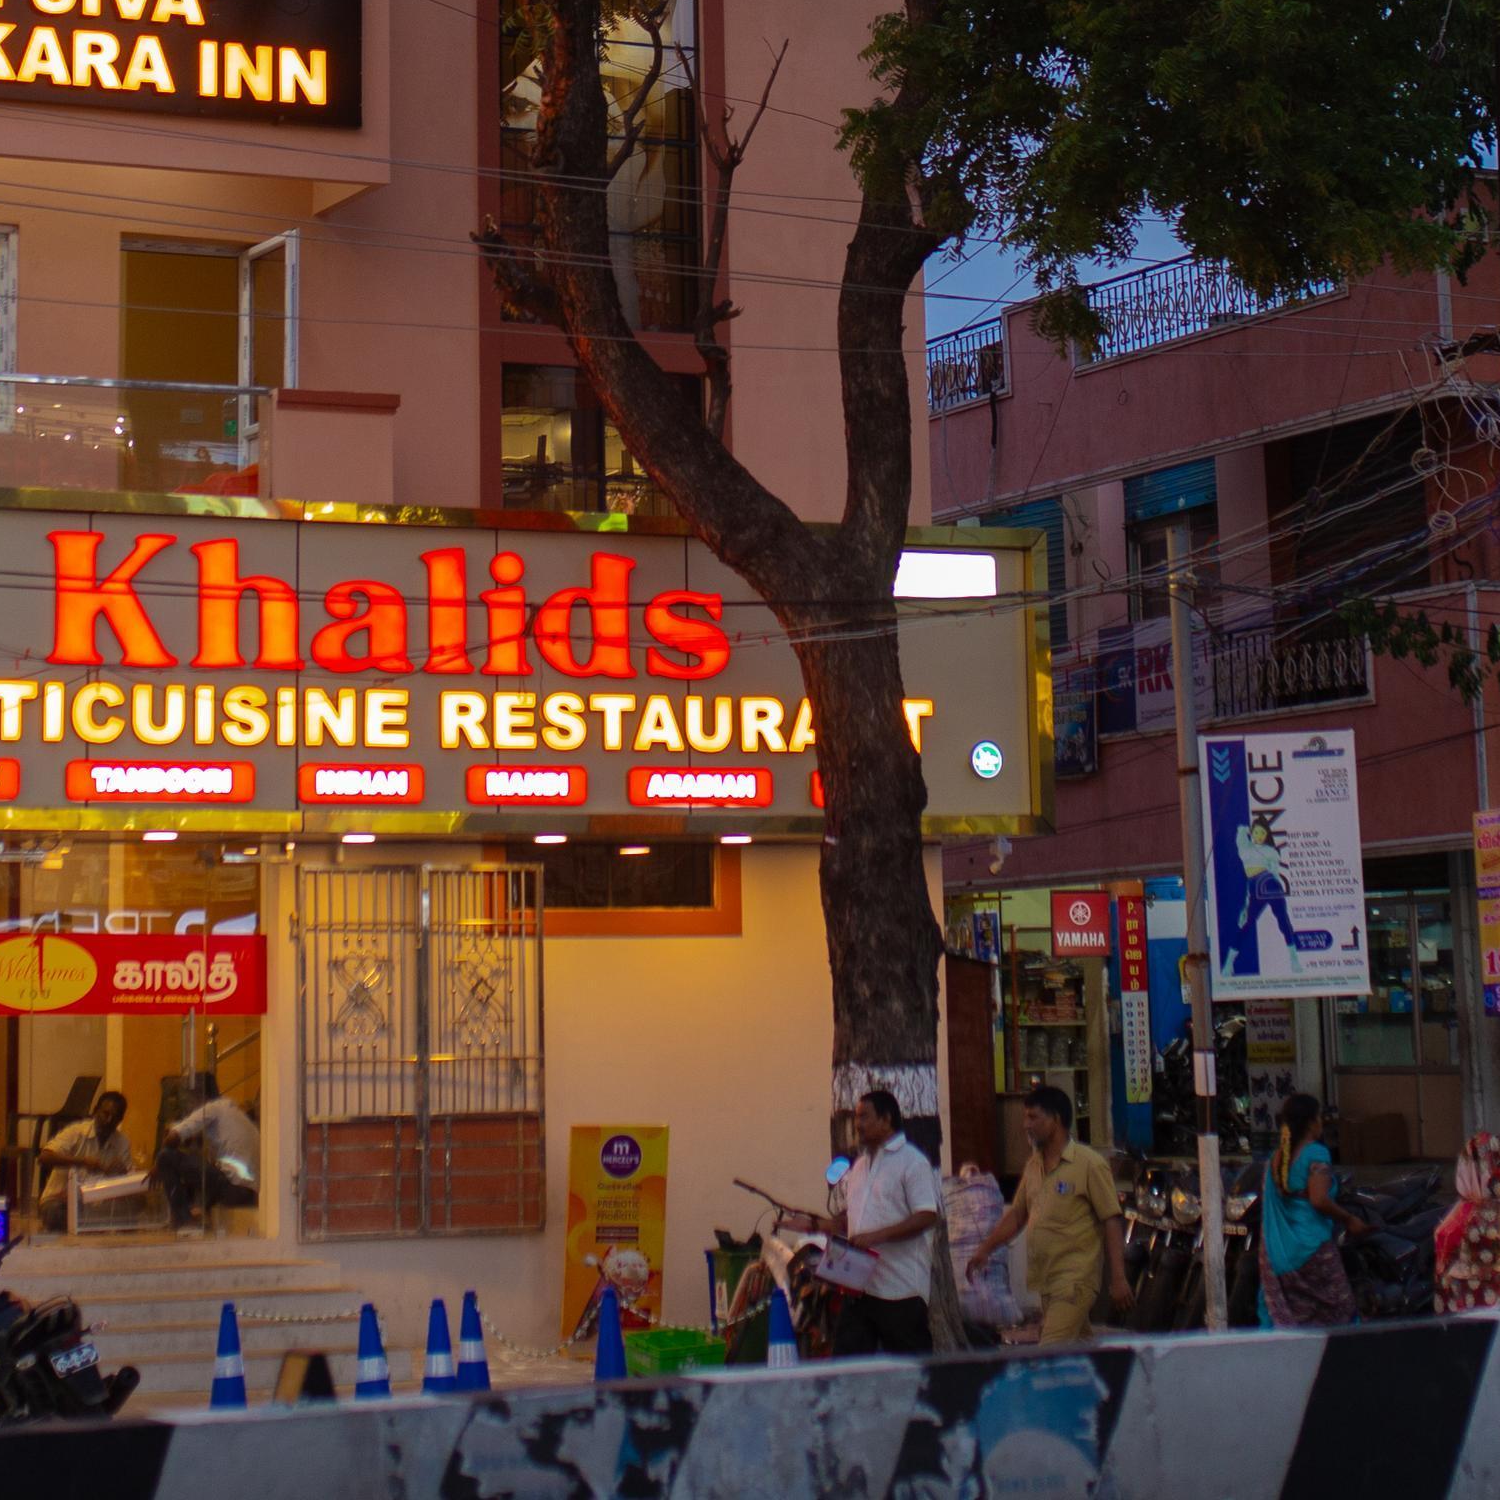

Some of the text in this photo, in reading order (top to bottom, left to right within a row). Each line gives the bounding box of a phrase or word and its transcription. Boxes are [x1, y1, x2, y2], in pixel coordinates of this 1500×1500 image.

[197, 39, 329, 107] INN
[44, 529, 732, 681] Khalids
[440, 689, 933, 754] RESTAURAT
[1056, 931, 1106, 948] YAMAHA
